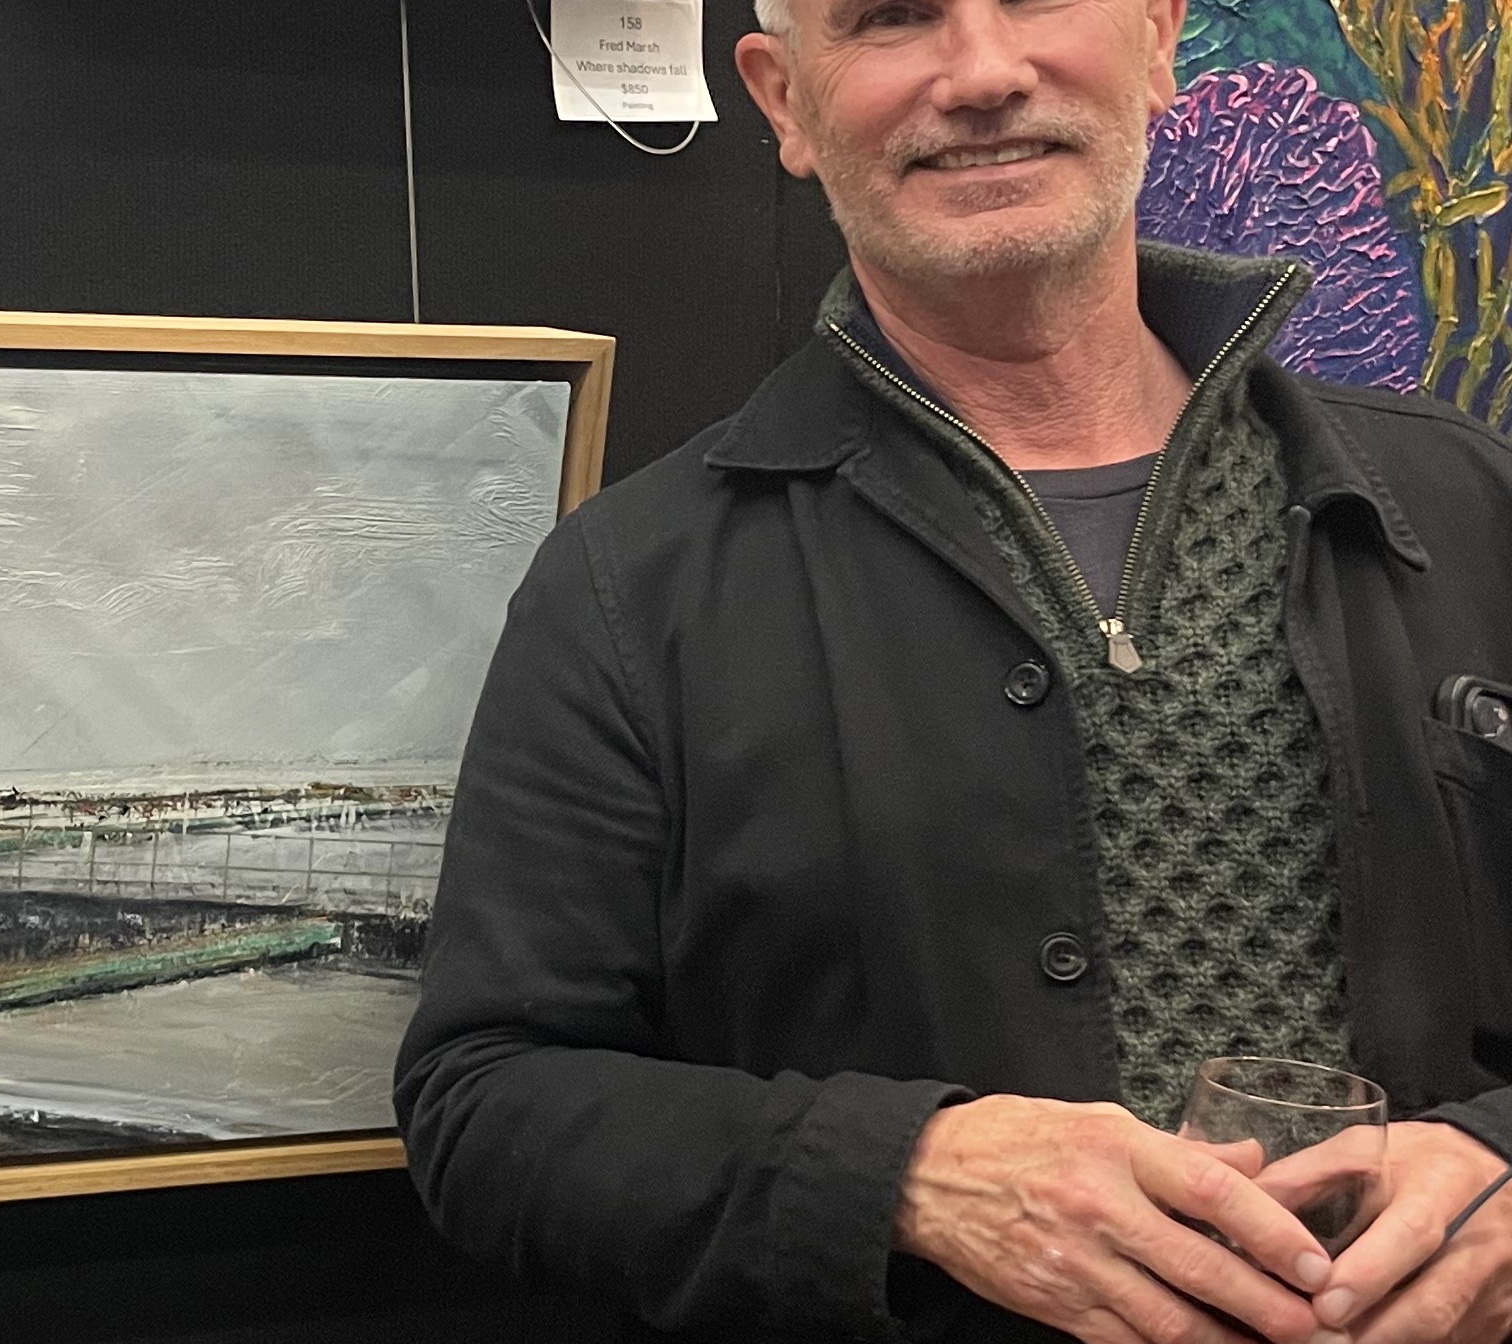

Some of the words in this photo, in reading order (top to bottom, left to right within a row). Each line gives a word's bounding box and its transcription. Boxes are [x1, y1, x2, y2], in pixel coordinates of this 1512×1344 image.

[620, 16, 642, 31] 158
[599, 39, 623, 52] Fred
[626, 41, 660, 54] Marsh
[576, 60, 614, 73] Where
[617, 61, 667, 76] shadows
